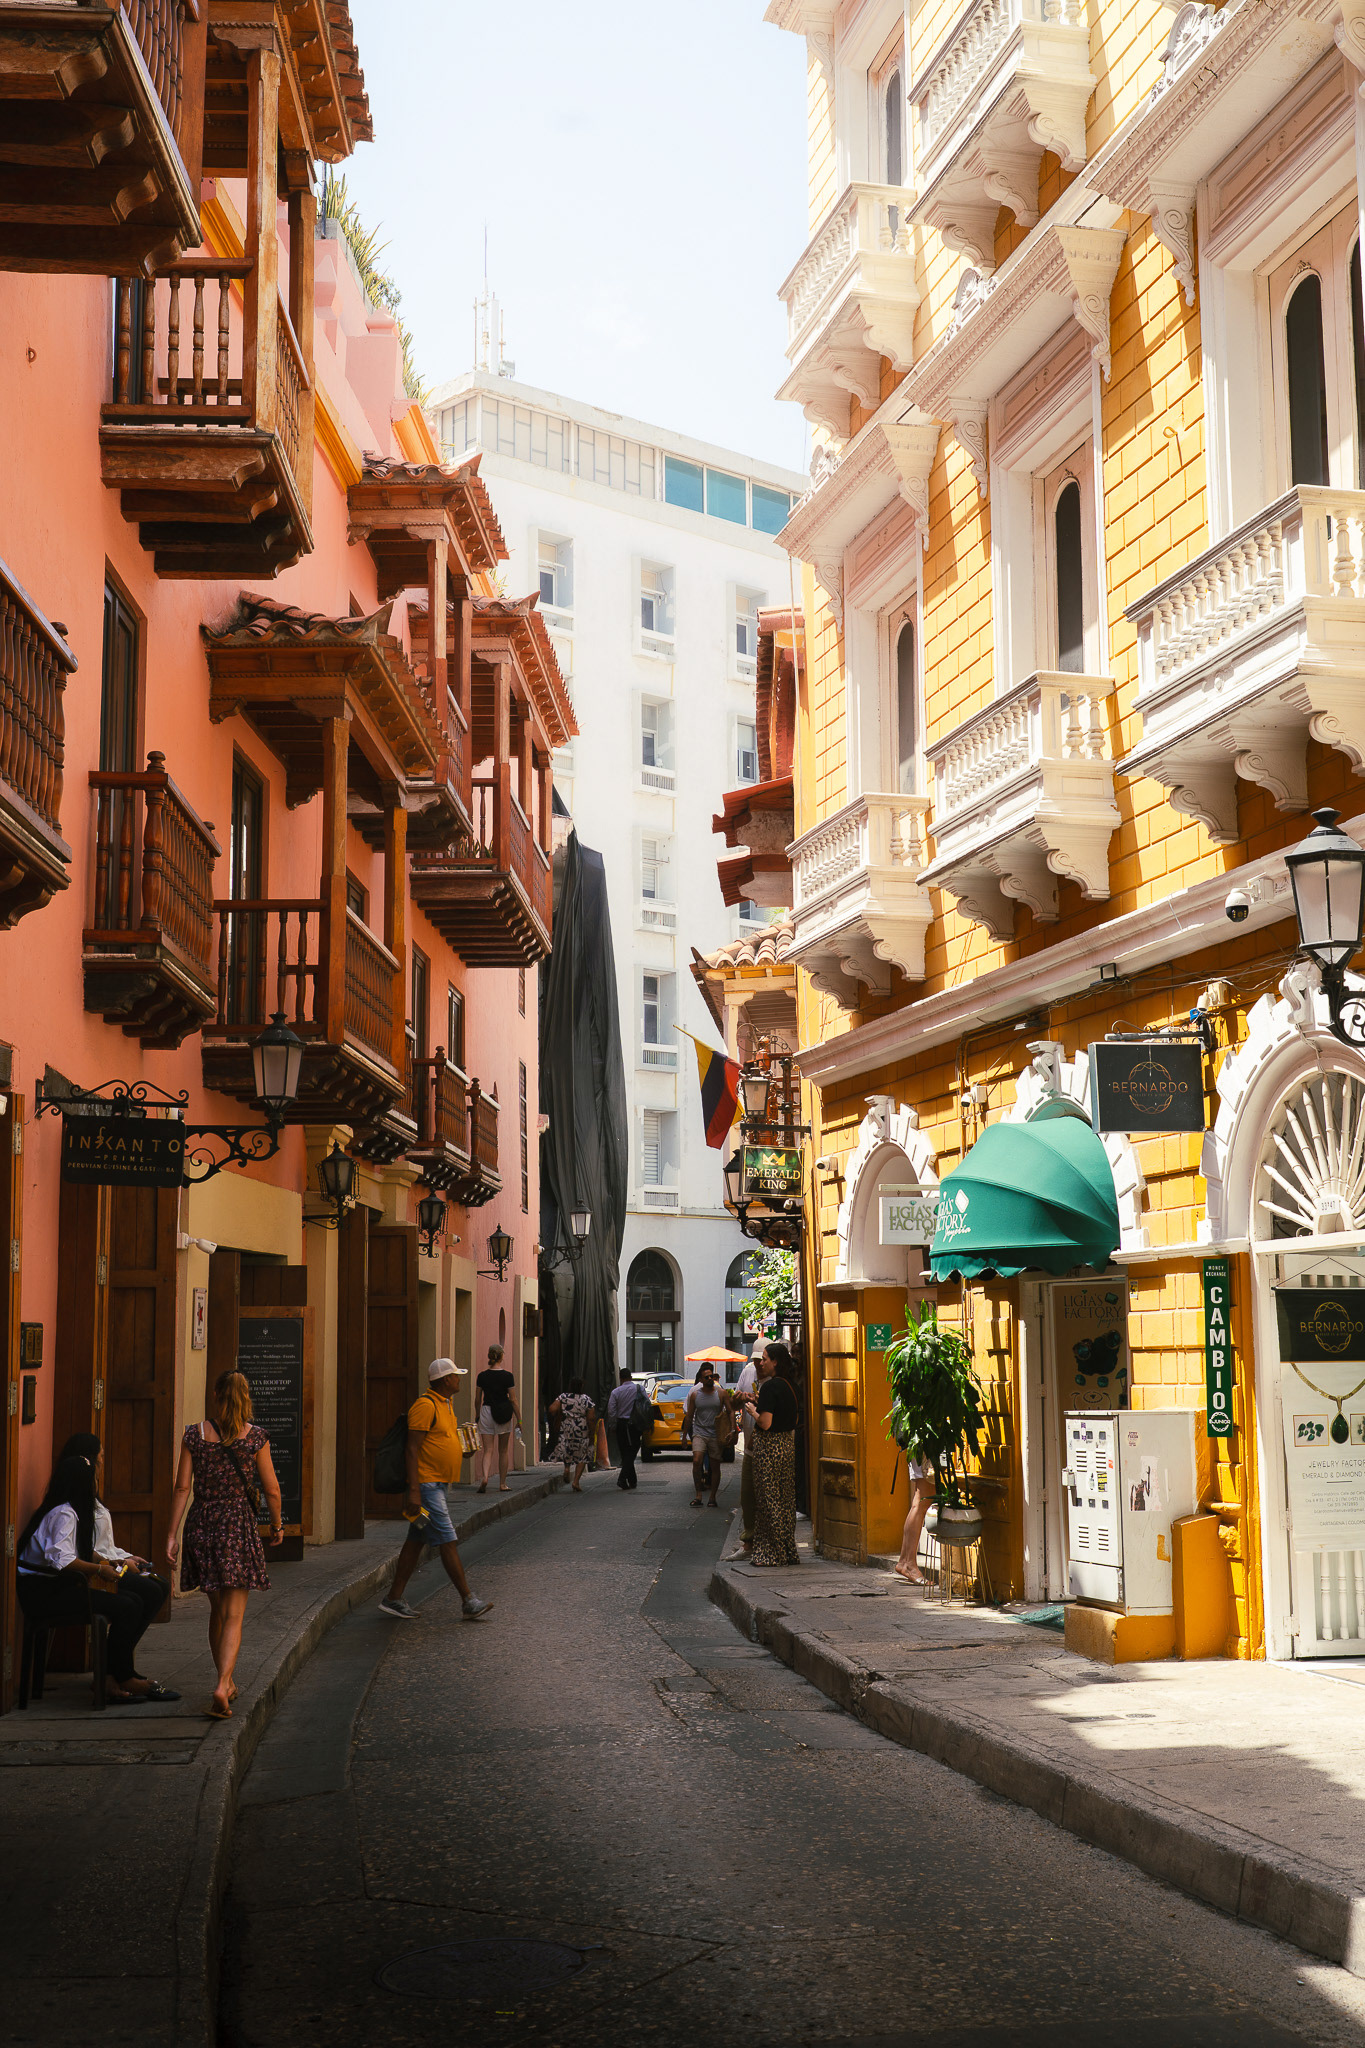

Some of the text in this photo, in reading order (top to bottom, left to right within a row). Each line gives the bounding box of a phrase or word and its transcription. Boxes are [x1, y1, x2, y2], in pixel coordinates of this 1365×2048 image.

[1112, 1081, 1188, 1093] BERNARDO
[69, 1132, 180, 1153] INKANTO
[103, 1154, 144, 1162] PRIME
[746, 1167, 801, 1180] EMERALD
[759, 1180, 788, 1190] KING
[1064, 1306, 1122, 1319] FACTORY
[1300, 1322, 1364, 1332] BERNARDO
[1210, 1286, 1226, 1410] CAMBIO
